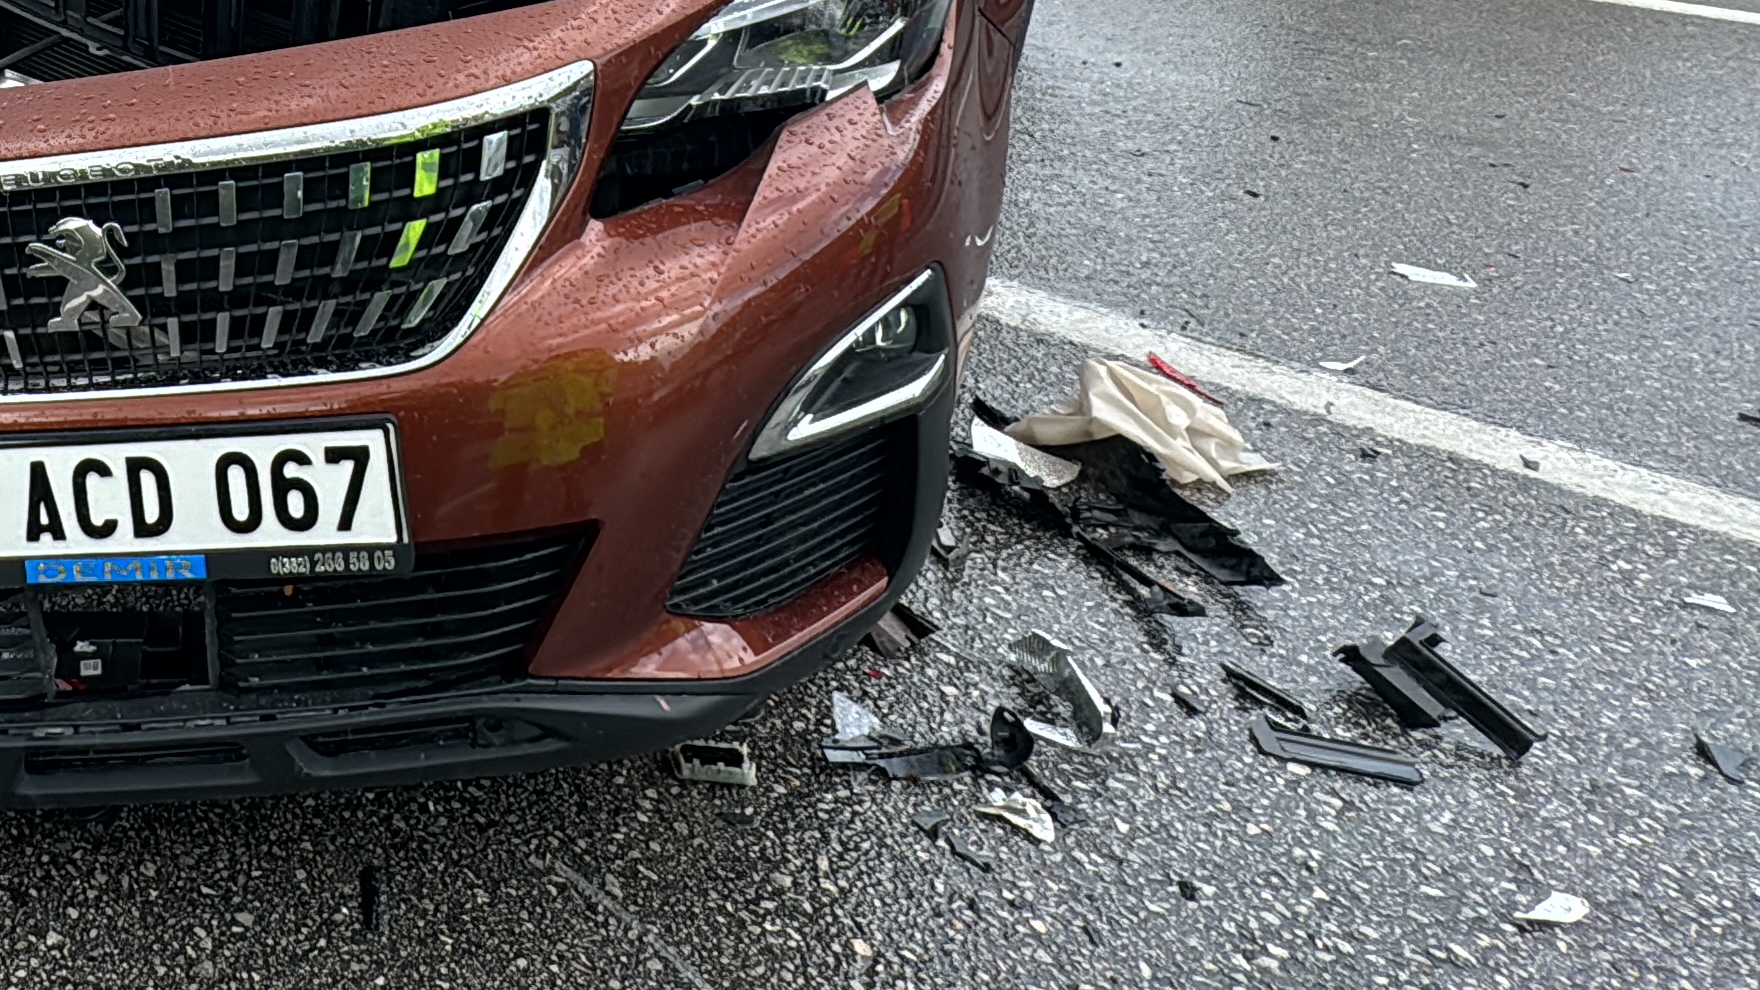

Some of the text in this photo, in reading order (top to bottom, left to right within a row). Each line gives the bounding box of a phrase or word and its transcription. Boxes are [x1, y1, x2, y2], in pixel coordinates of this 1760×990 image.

[26, 456, 173, 542] ACD
[215, 444, 370, 534] 067
[349, 551, 370, 571] 58
[374, 550, 395, 570] 05
